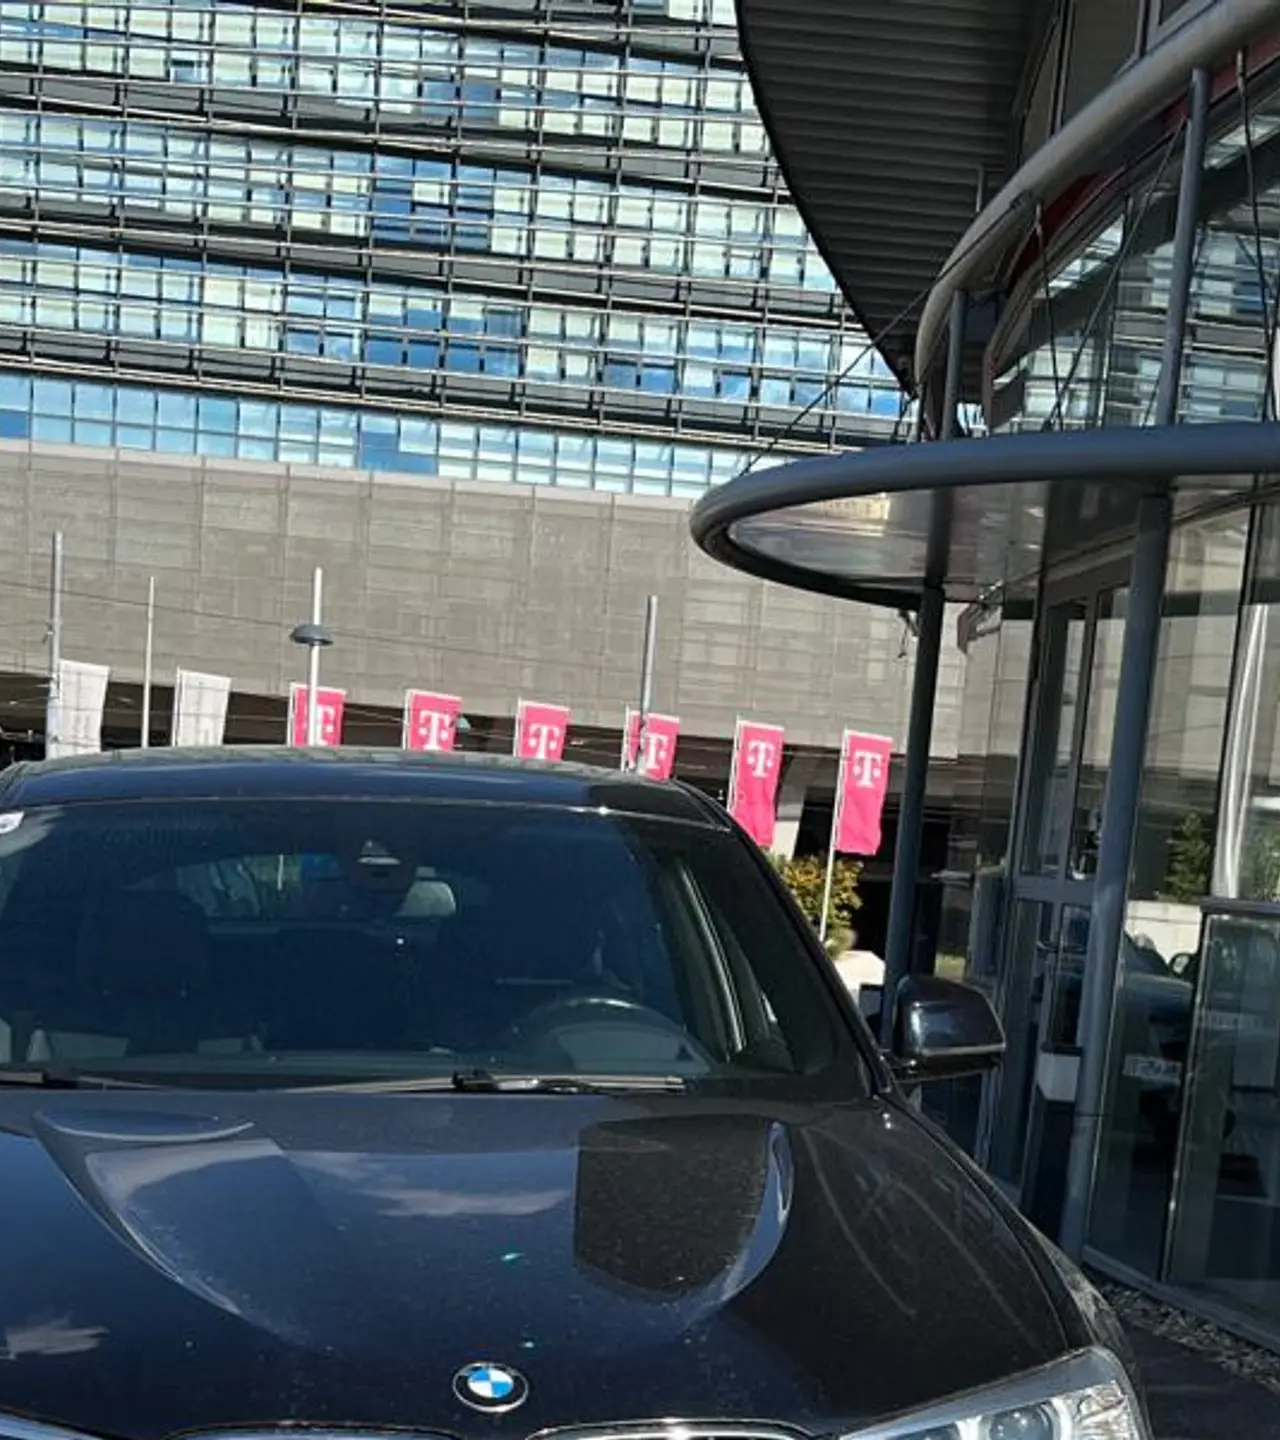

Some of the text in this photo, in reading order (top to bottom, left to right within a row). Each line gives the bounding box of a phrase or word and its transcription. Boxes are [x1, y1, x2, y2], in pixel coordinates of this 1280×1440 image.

[419, 709, 452, 750] T
[527, 723, 560, 760] T
[747, 739, 775, 778] T
[853, 751, 882, 788] T
